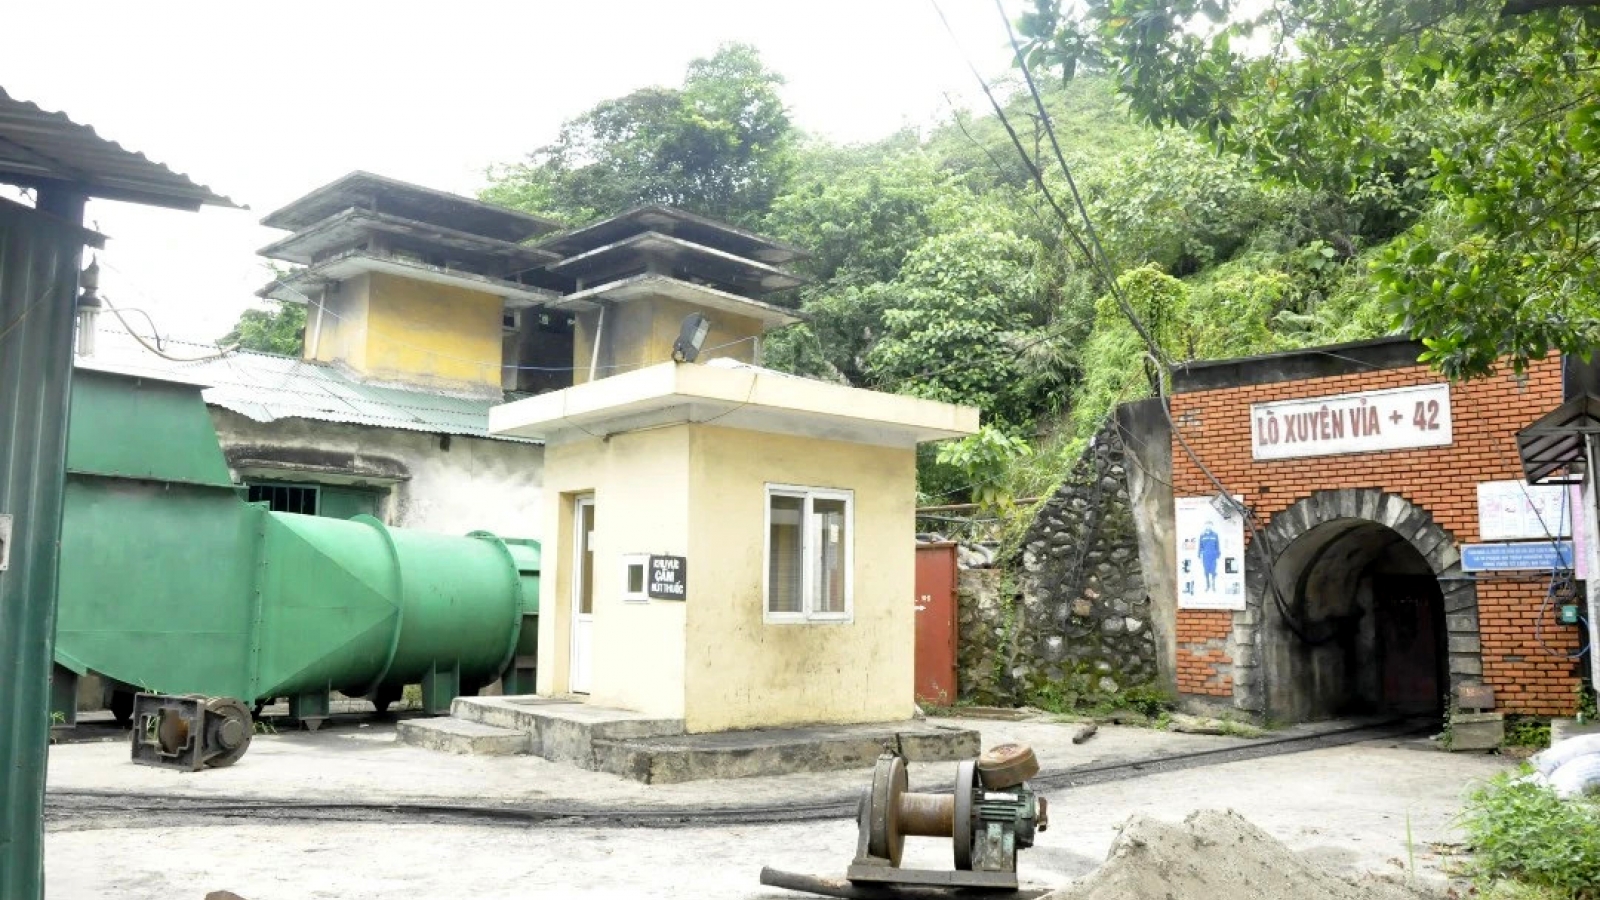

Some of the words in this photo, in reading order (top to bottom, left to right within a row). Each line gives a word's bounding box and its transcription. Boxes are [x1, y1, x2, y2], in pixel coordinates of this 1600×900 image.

[1258, 410, 1280, 446] LÒ
[1284, 404, 1345, 443] XUYÊN
[1350, 398, 1381, 437] VỈA
[1388, 410, 1404, 425] +
[1412, 399, 1440, 431] 42
